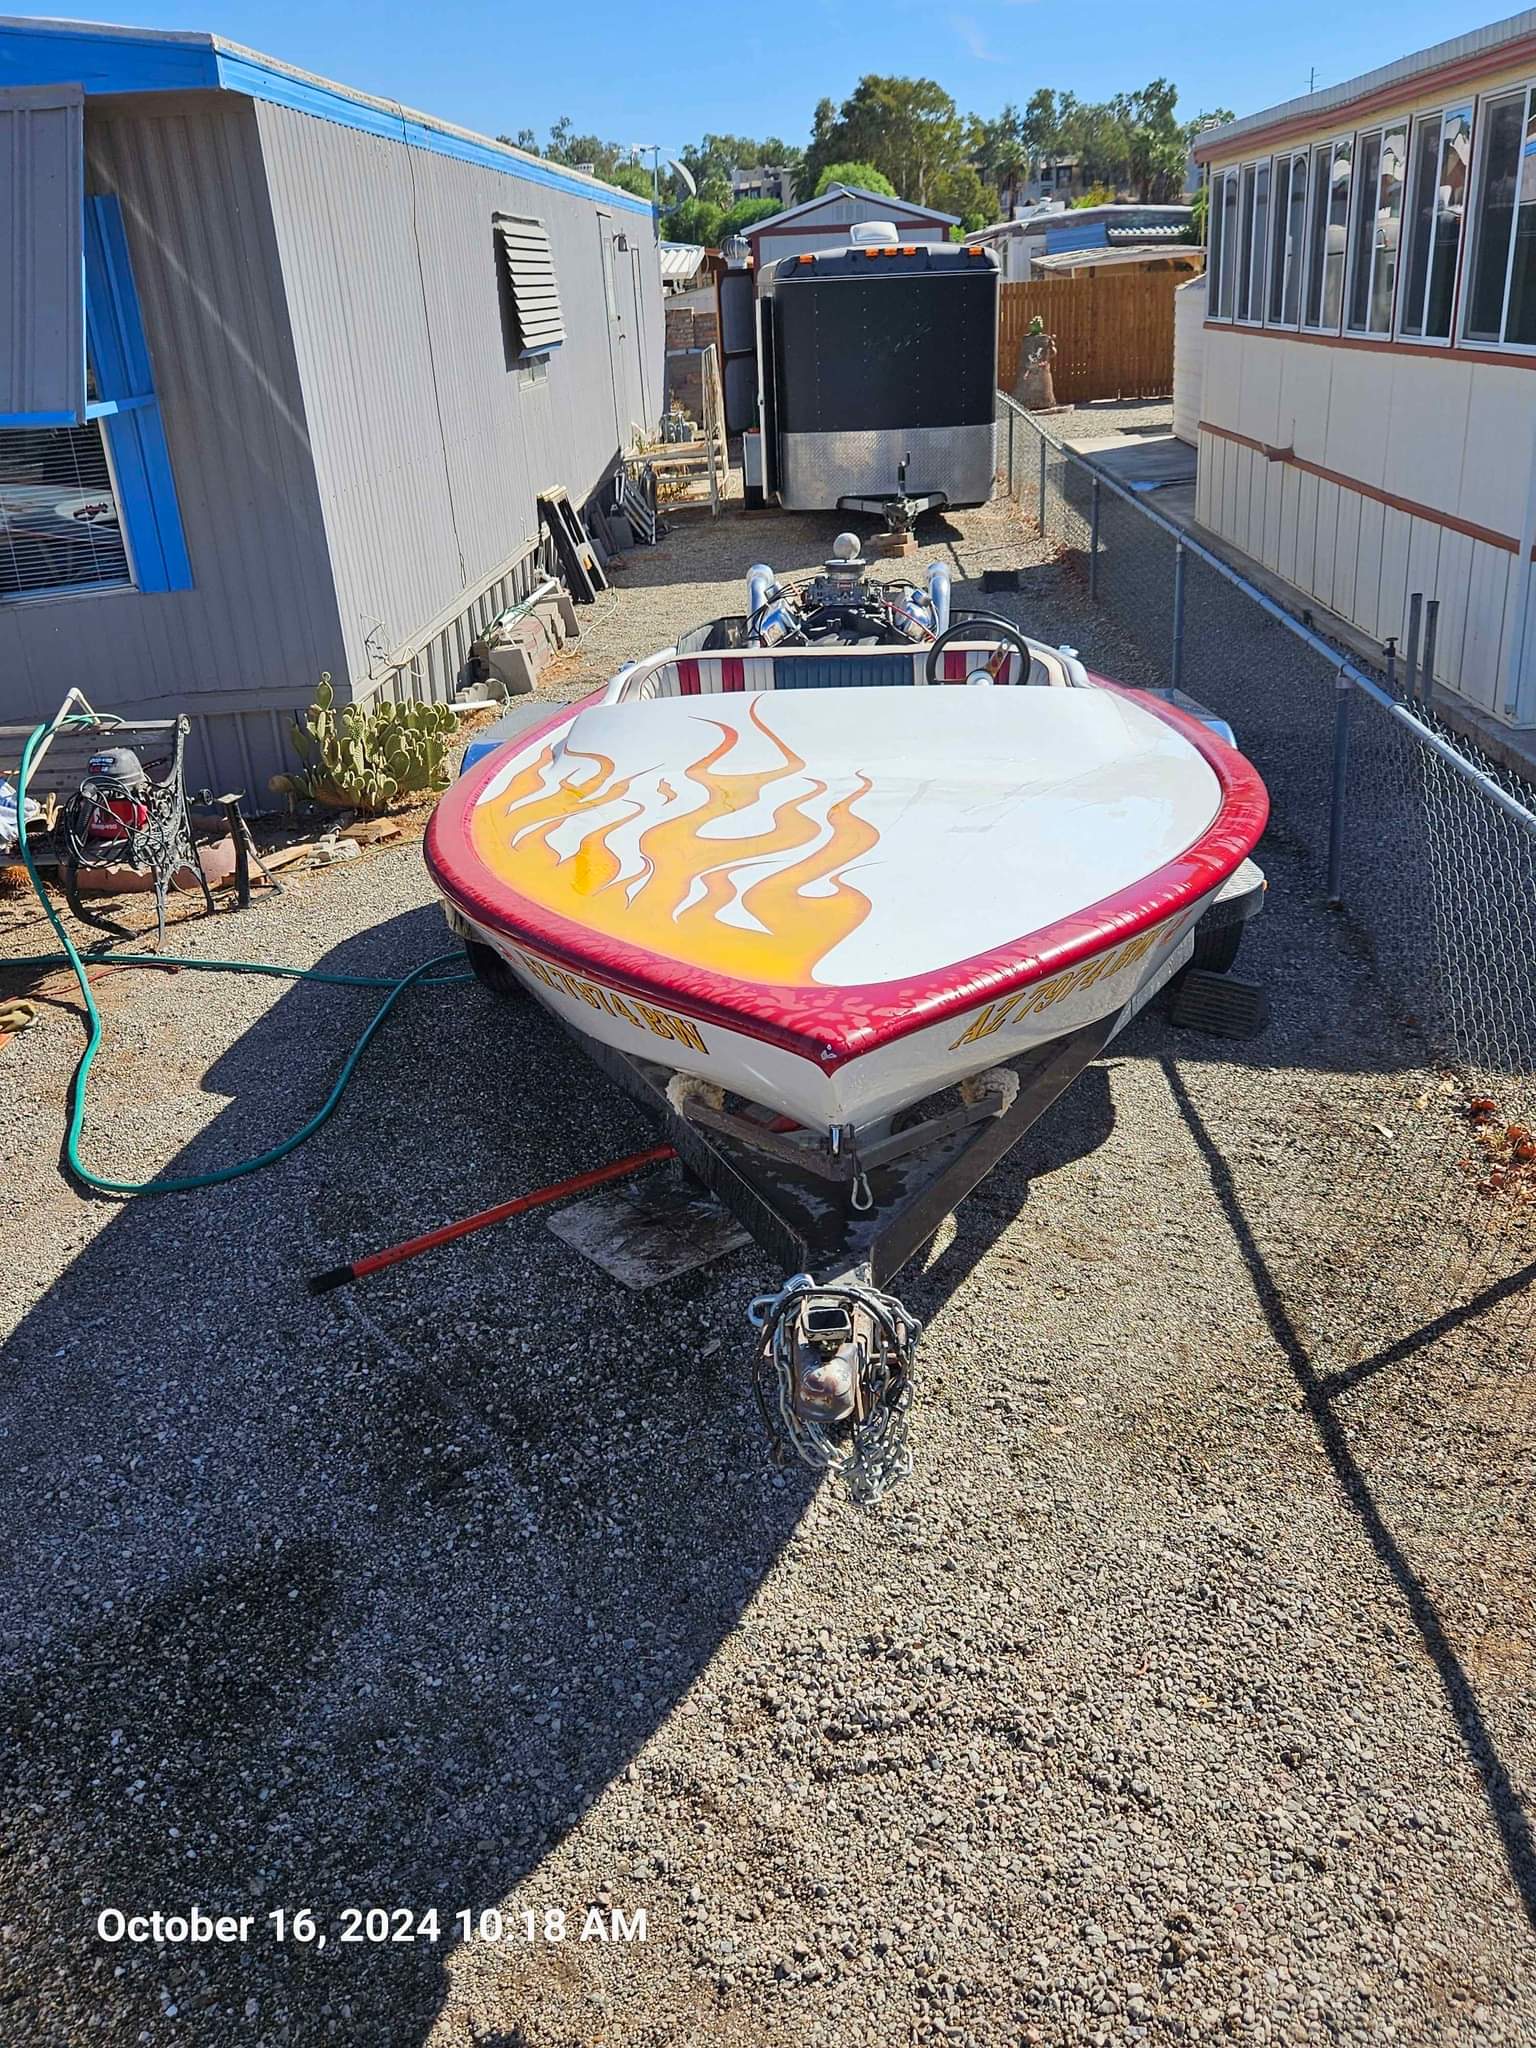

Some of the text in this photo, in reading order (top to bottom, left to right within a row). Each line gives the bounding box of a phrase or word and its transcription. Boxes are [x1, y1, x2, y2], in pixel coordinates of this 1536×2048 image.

[546, 965, 645, 1030] 7974
[629, 1000, 711, 1055] BW
[948, 993, 1026, 1051] AZ
[1012, 951, 1117, 1023] 7974
